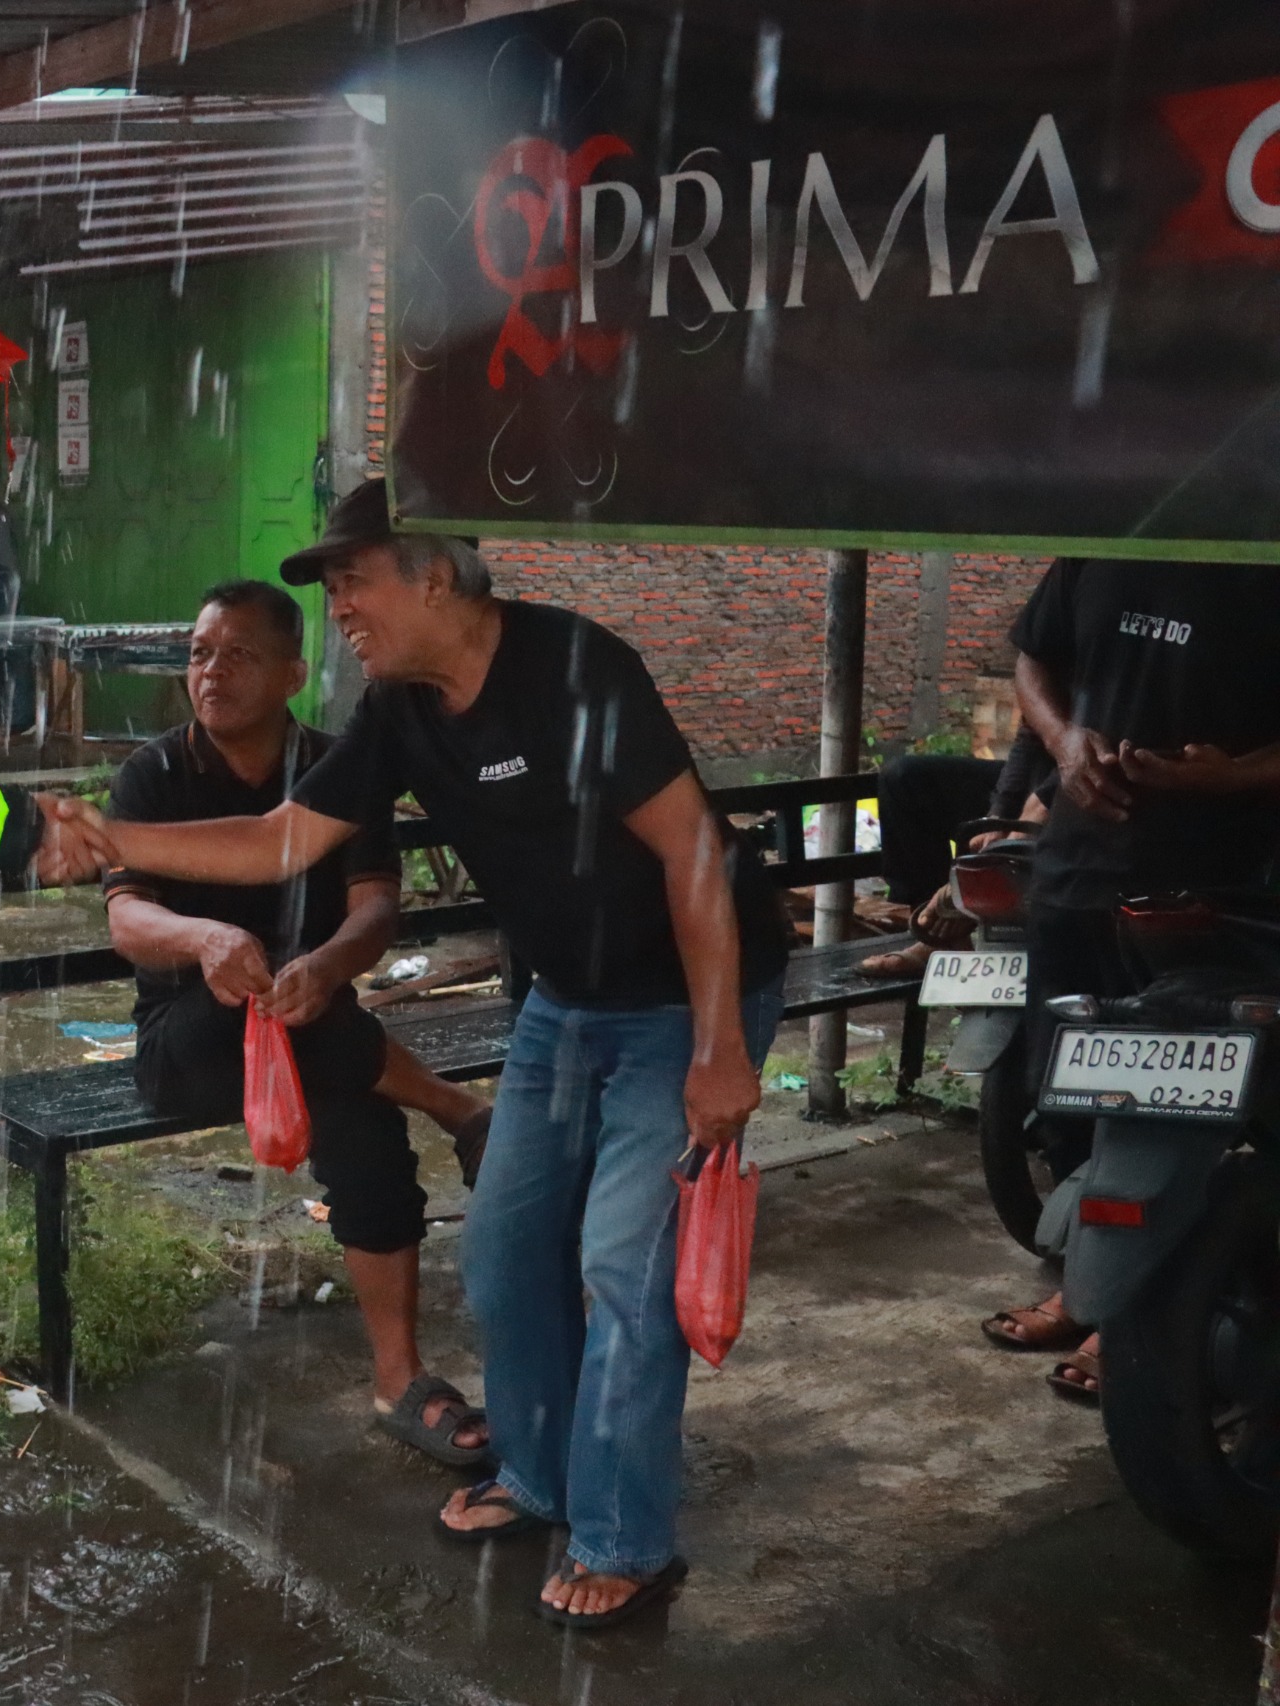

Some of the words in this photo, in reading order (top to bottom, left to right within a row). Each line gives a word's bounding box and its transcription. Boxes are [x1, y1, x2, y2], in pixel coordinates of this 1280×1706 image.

[579, 113, 1099, 325] PRIMA
[1119, 611, 1165, 639] LET'S
[1164, 620, 1192, 645] DO
[933, 957, 961, 977] AD
[967, 956, 1022, 977] 2618
[1056, 1095, 1093, 1106] YAMAHA
[1136, 1106, 1183, 1114] SEMAKIN
[1196, 1109, 1235, 1117] DEPAN
